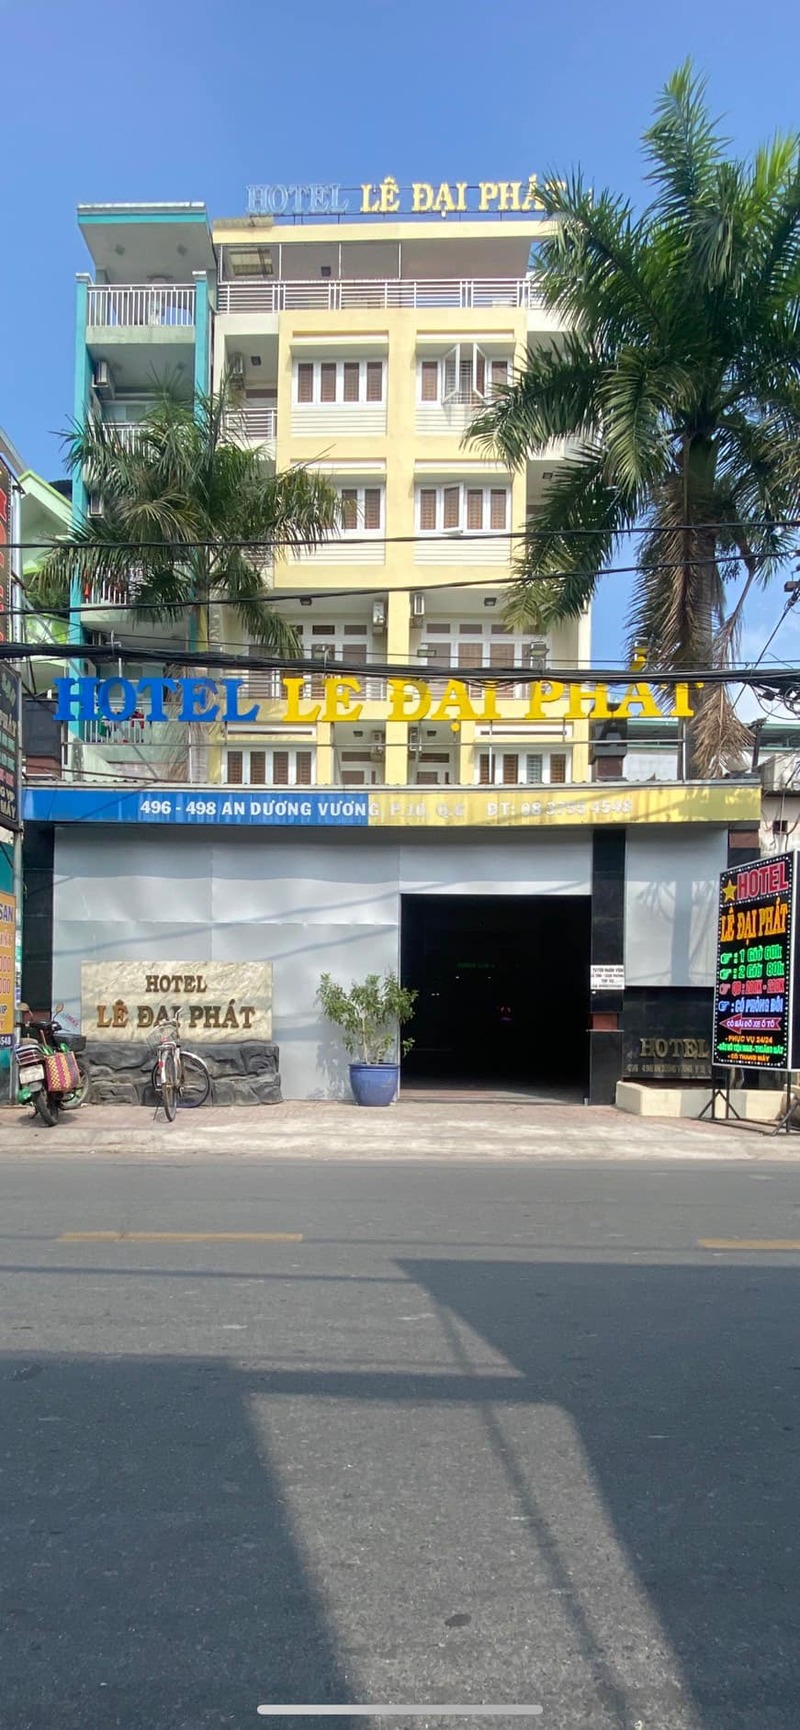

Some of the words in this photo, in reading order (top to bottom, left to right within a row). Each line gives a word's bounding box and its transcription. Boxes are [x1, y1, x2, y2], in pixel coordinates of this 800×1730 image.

[246, 183, 350, 213] HOTEL
[360, 175, 399, 212] LÊ
[411, 181, 467, 218] ĐẠI
[53, 676, 259, 722] HOTEL
[387, 677, 501, 733] ĐẠI
[140, 800, 172, 815] 496
[186, 800, 217, 816] 498
[221, 801, 246, 816] AN
[250, 800, 312, 817] DƯƠNG
[520, 801, 542, 816] 08
[737, 861, 789, 900] HOTEL
[720, 906, 735, 942] LÊ
[737, 910, 757, 946] ĐẠI
[758, 896, 788, 937] PHÁT
[739, 949, 745, 963] 1
[146, 975, 207, 993] HOTEL
[738, 964, 745, 979] 2
[97, 999, 129, 1028] LÊ
[189, 998, 256, 1029] PHÁT
[639, 1038, 710, 1058] HOTEL
